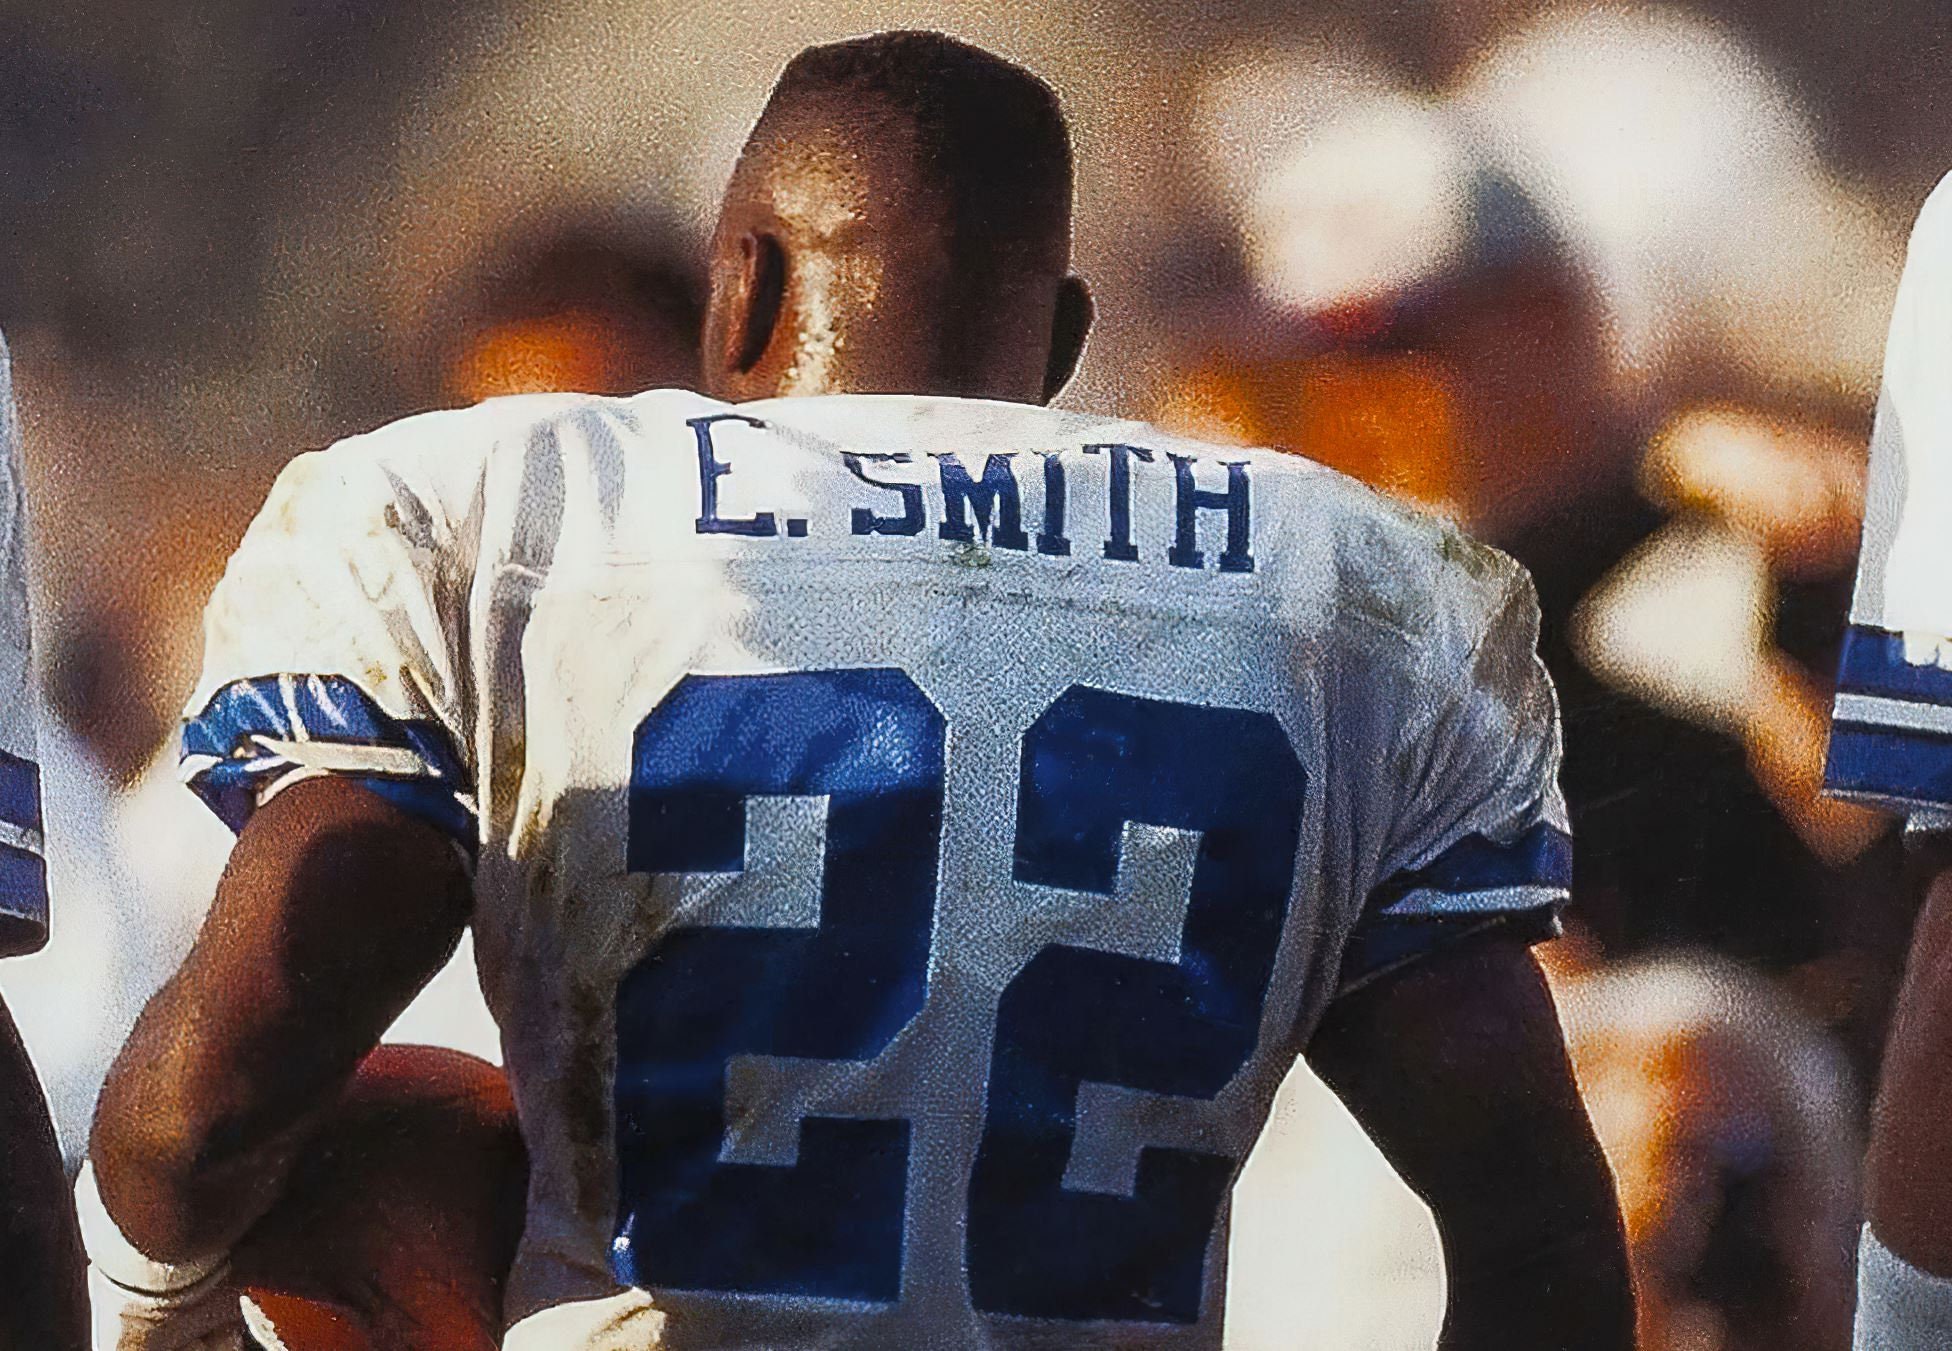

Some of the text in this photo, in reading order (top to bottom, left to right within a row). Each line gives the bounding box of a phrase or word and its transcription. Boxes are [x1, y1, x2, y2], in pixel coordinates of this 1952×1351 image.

[685, 413, 1256, 574] E. SMITH
[609, 667, 1309, 1324] 22
